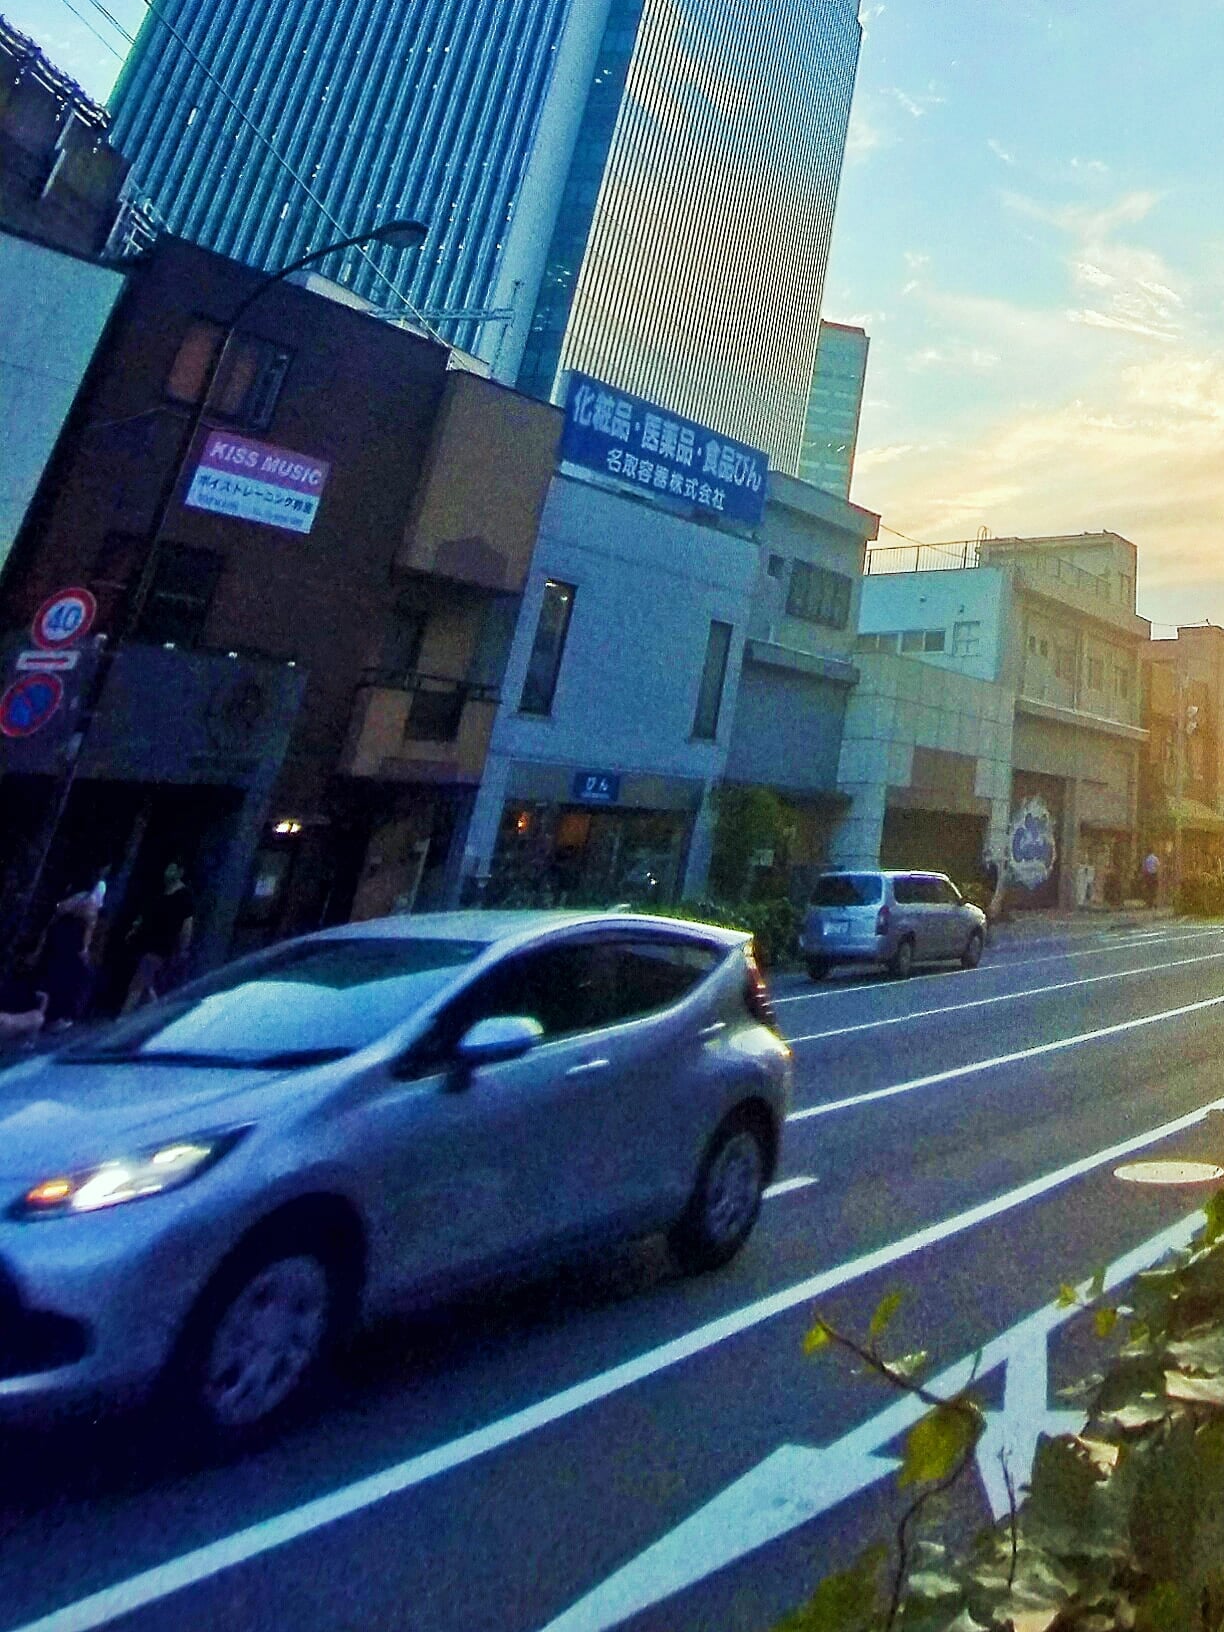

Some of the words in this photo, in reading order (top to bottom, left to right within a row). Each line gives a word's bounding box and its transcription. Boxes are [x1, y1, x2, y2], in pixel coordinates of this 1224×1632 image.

[210, 441, 260, 467] KISS
[261, 455, 322, 485] MUSIC
[606, 448, 727, 511] 名取容器株式会社
[47, 605, 83, 632] 40
